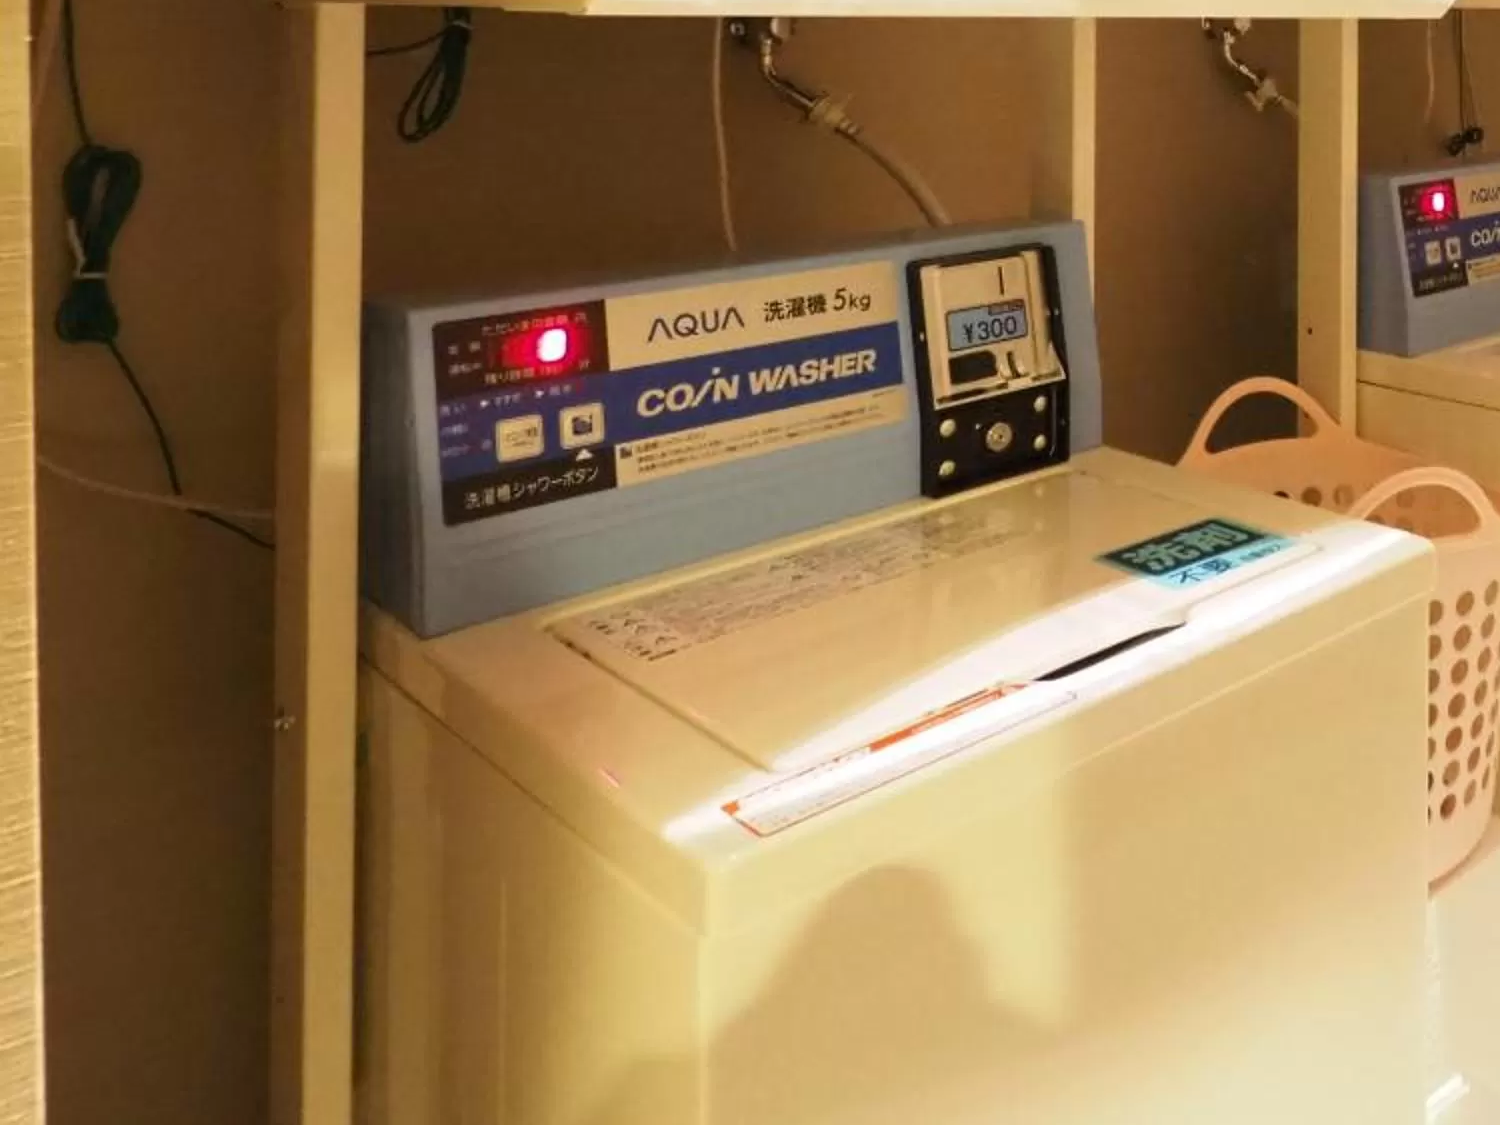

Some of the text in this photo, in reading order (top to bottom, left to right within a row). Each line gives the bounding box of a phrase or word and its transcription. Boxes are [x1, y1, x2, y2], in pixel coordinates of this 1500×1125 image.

[647, 286, 872, 343] AQUA 洗濯機 5kg
[963, 315, 1018, 344] ¥300
[637, 349, 878, 418] COIN WASHER
